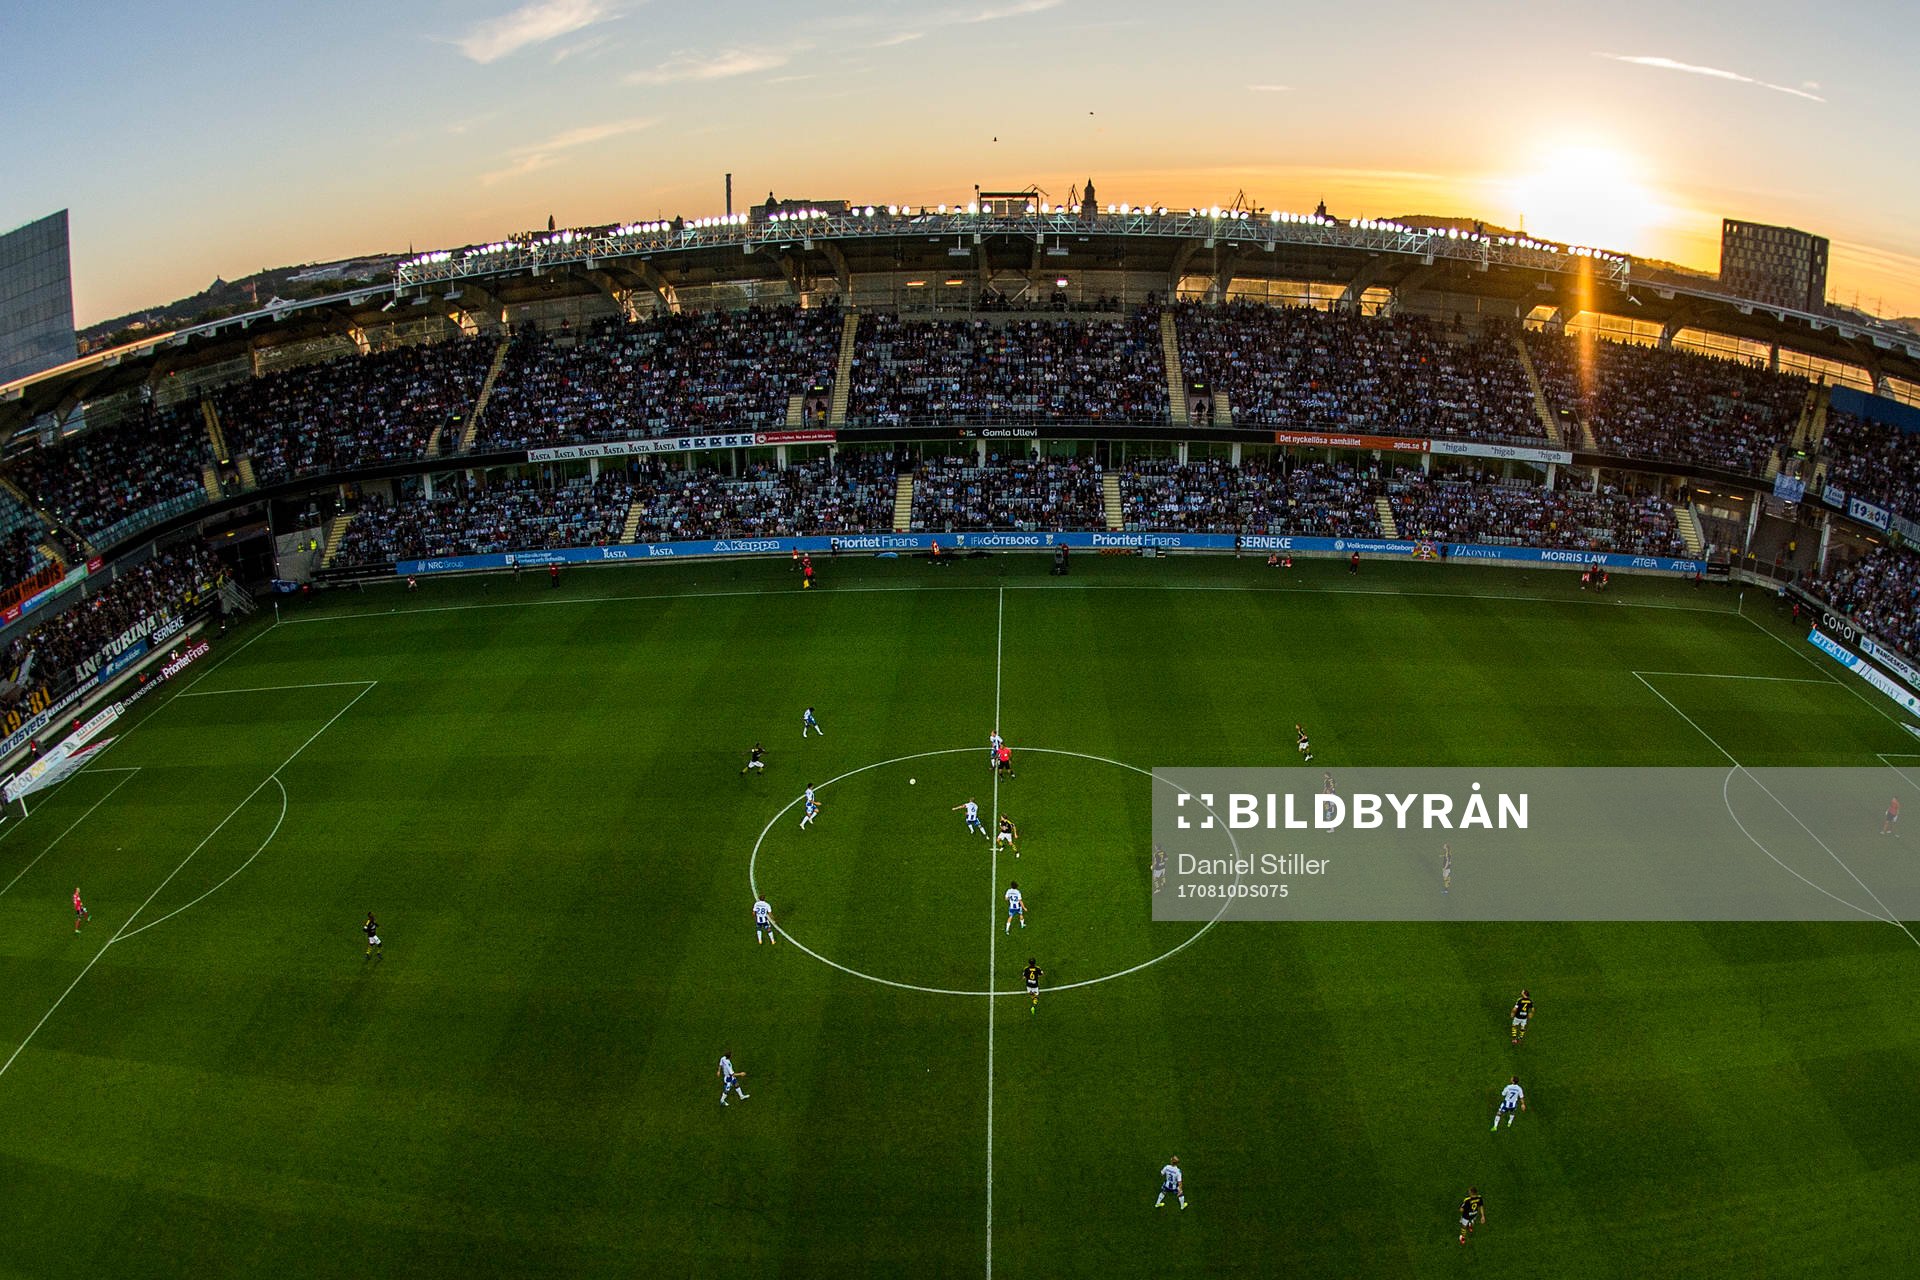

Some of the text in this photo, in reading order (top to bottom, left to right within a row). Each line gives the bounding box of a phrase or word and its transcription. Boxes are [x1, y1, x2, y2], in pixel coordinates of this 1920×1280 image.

[982, 428, 1011, 437] Gamla
[1012, 428, 1038, 437] Ullevi
[1280, 434, 1361, 447] Det nyckellösa samhället
[1393, 441, 1419, 450] aptus.se
[603, 446, 624, 455] RASTA
[628, 445, 650, 453] RASTA
[654, 442, 675, 452] RASTA
[530, 452, 551, 461] RASTA
[554, 450, 575, 459] RASTA
[578, 448, 600, 458] RASTA
[830, 536, 919, 548] Prioritet Finans
[1092, 534, 1181, 546] Prioritet Finans
[1239, 536, 1291, 549] SERNEKE
[730, 540, 780, 551] Kappa
[1347, 541, 1415, 553] Volkswagen Göteborg
[602, 549, 628, 559] RASTA
[649, 547, 674, 556] RASTA
[1541, 550, 1608, 565] MORRIS LAW
[1632, 557, 1658, 568] ATEA
[428, 560, 464, 570] NRC Group
[1670, 560, 1696, 571] ATEA
[152, 615, 185, 645] SERNEKE
[162, 643, 210, 679] Prioritet Finans
